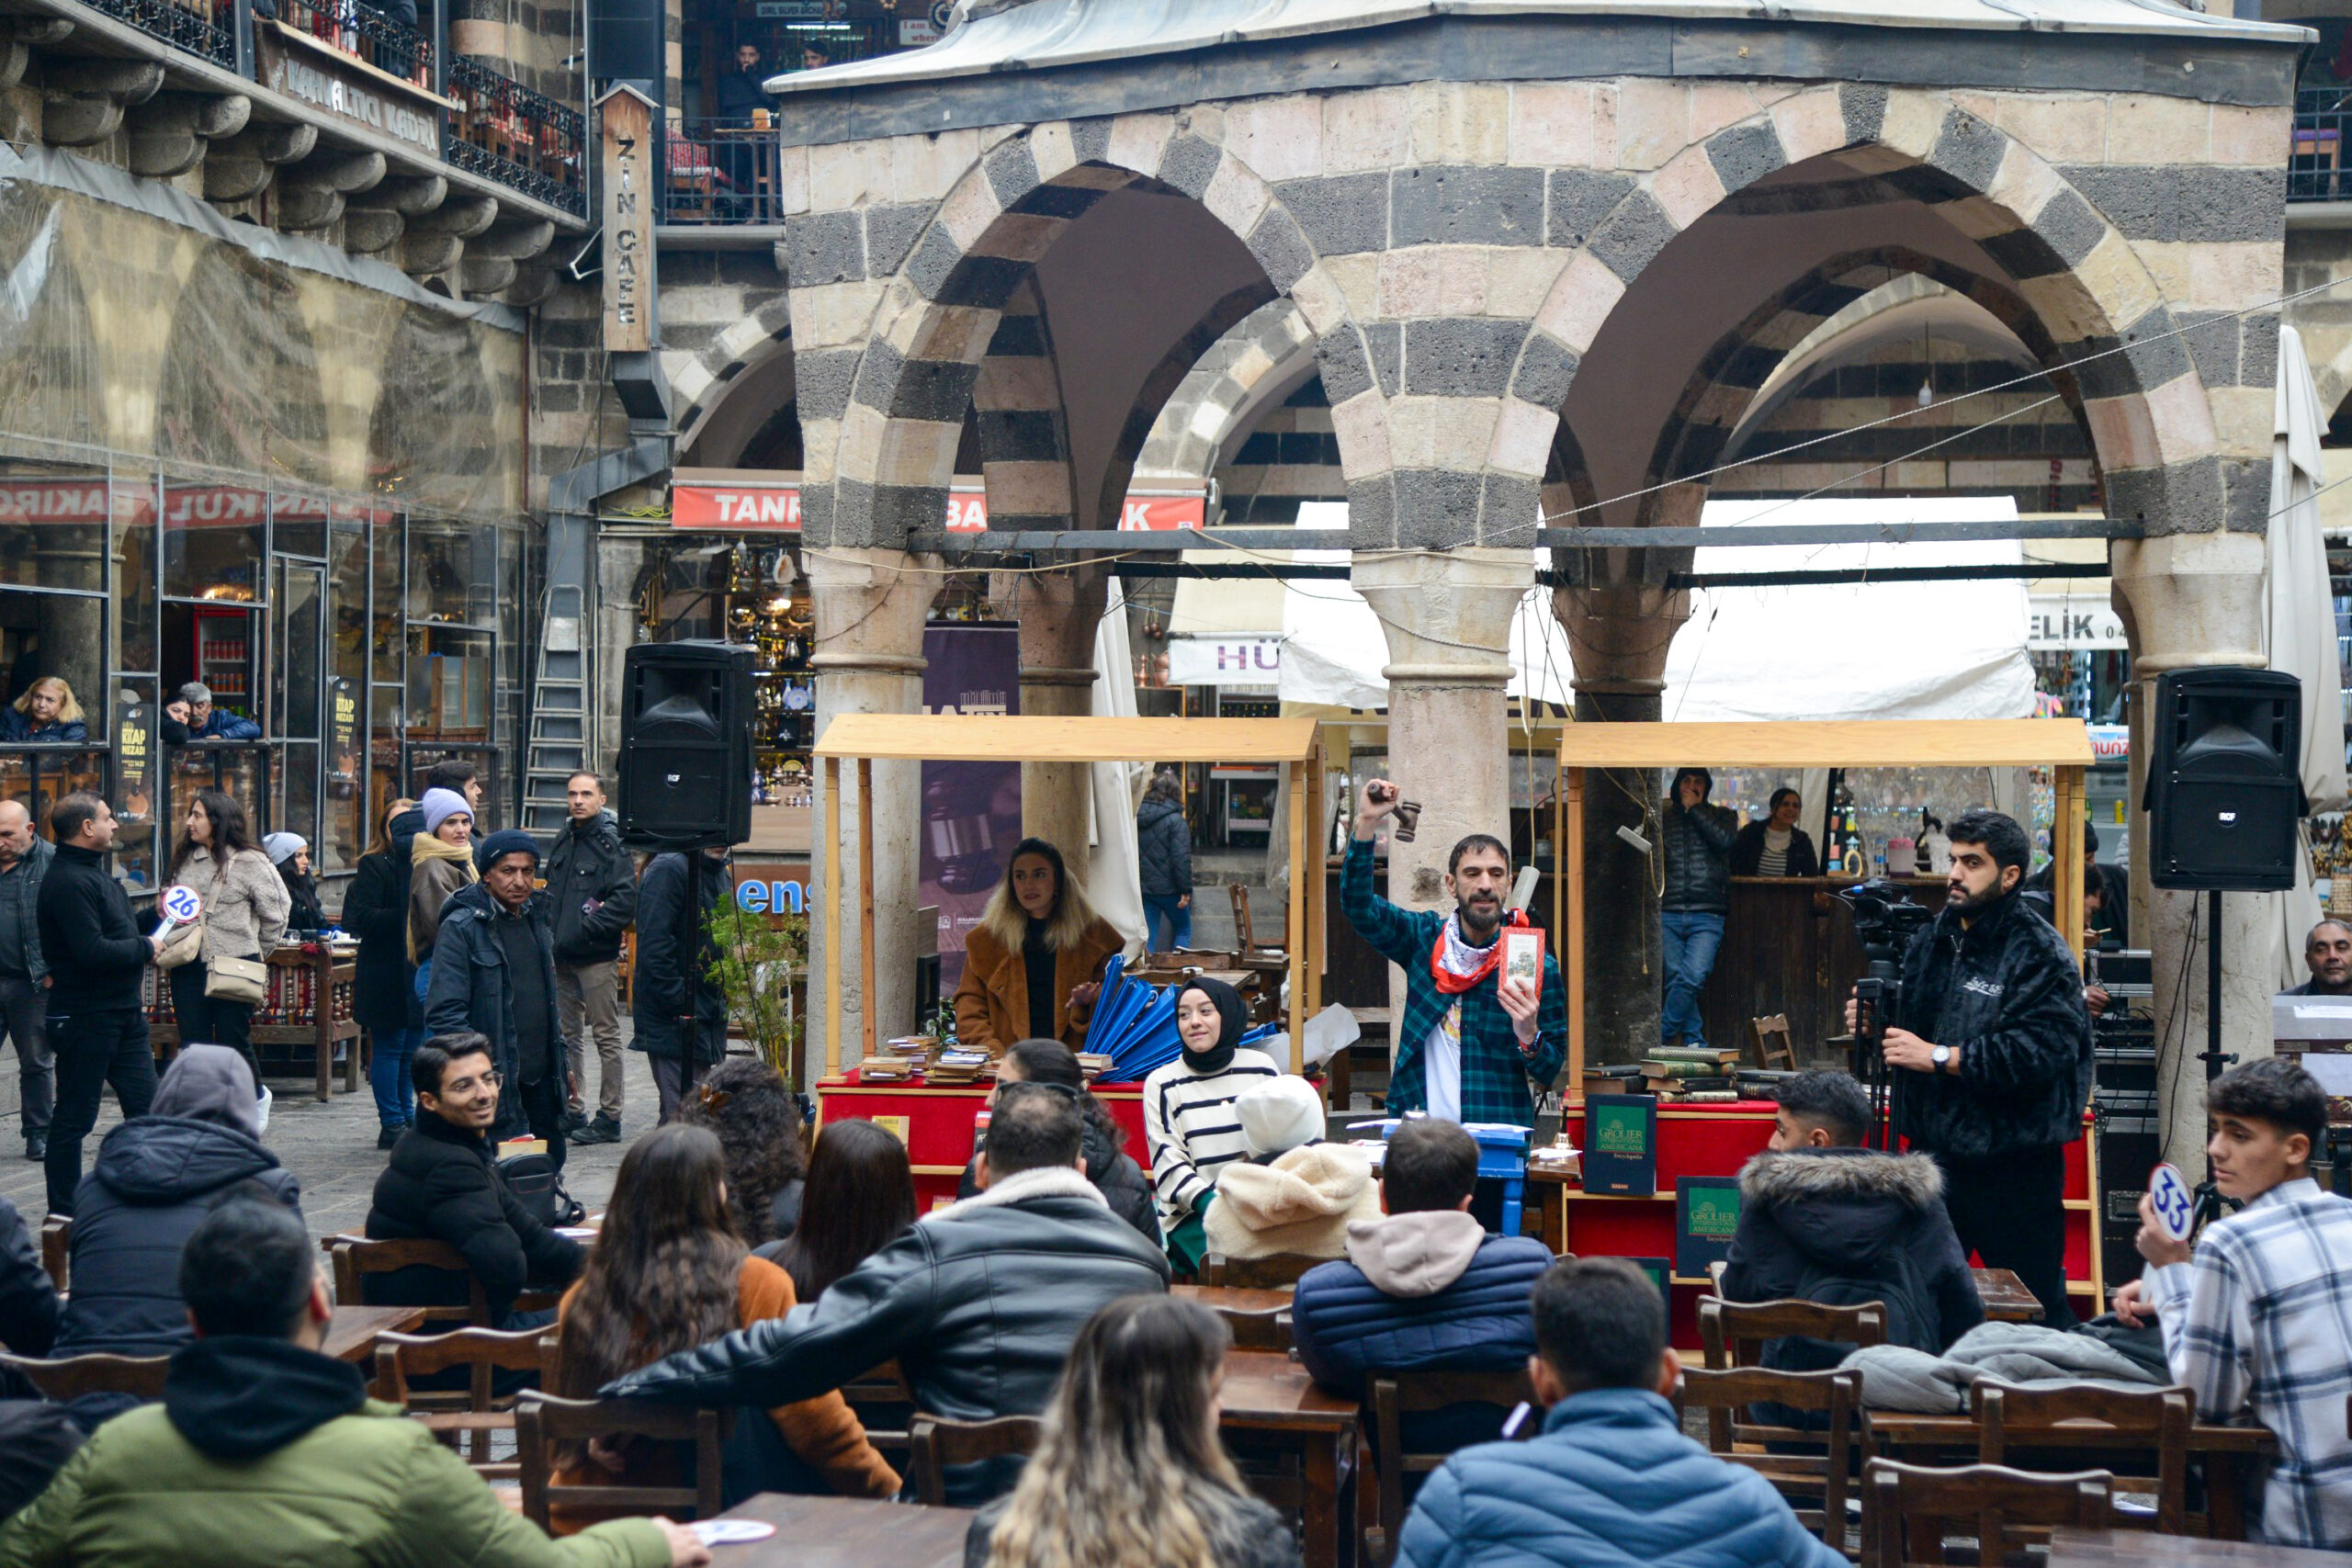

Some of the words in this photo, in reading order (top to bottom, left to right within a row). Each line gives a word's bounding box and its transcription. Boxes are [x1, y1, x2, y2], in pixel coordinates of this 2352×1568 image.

[616, 230, 637, 324] CAFE
[2219, 812, 2235, 821] RCF
[167, 888, 198, 917] 26
[737, 879, 812, 915] en
[1599, 1128, 1643, 1140] GROLIER
[1690, 1211, 1736, 1222] GROLIER
[2154, 1169, 2191, 1235] 33
